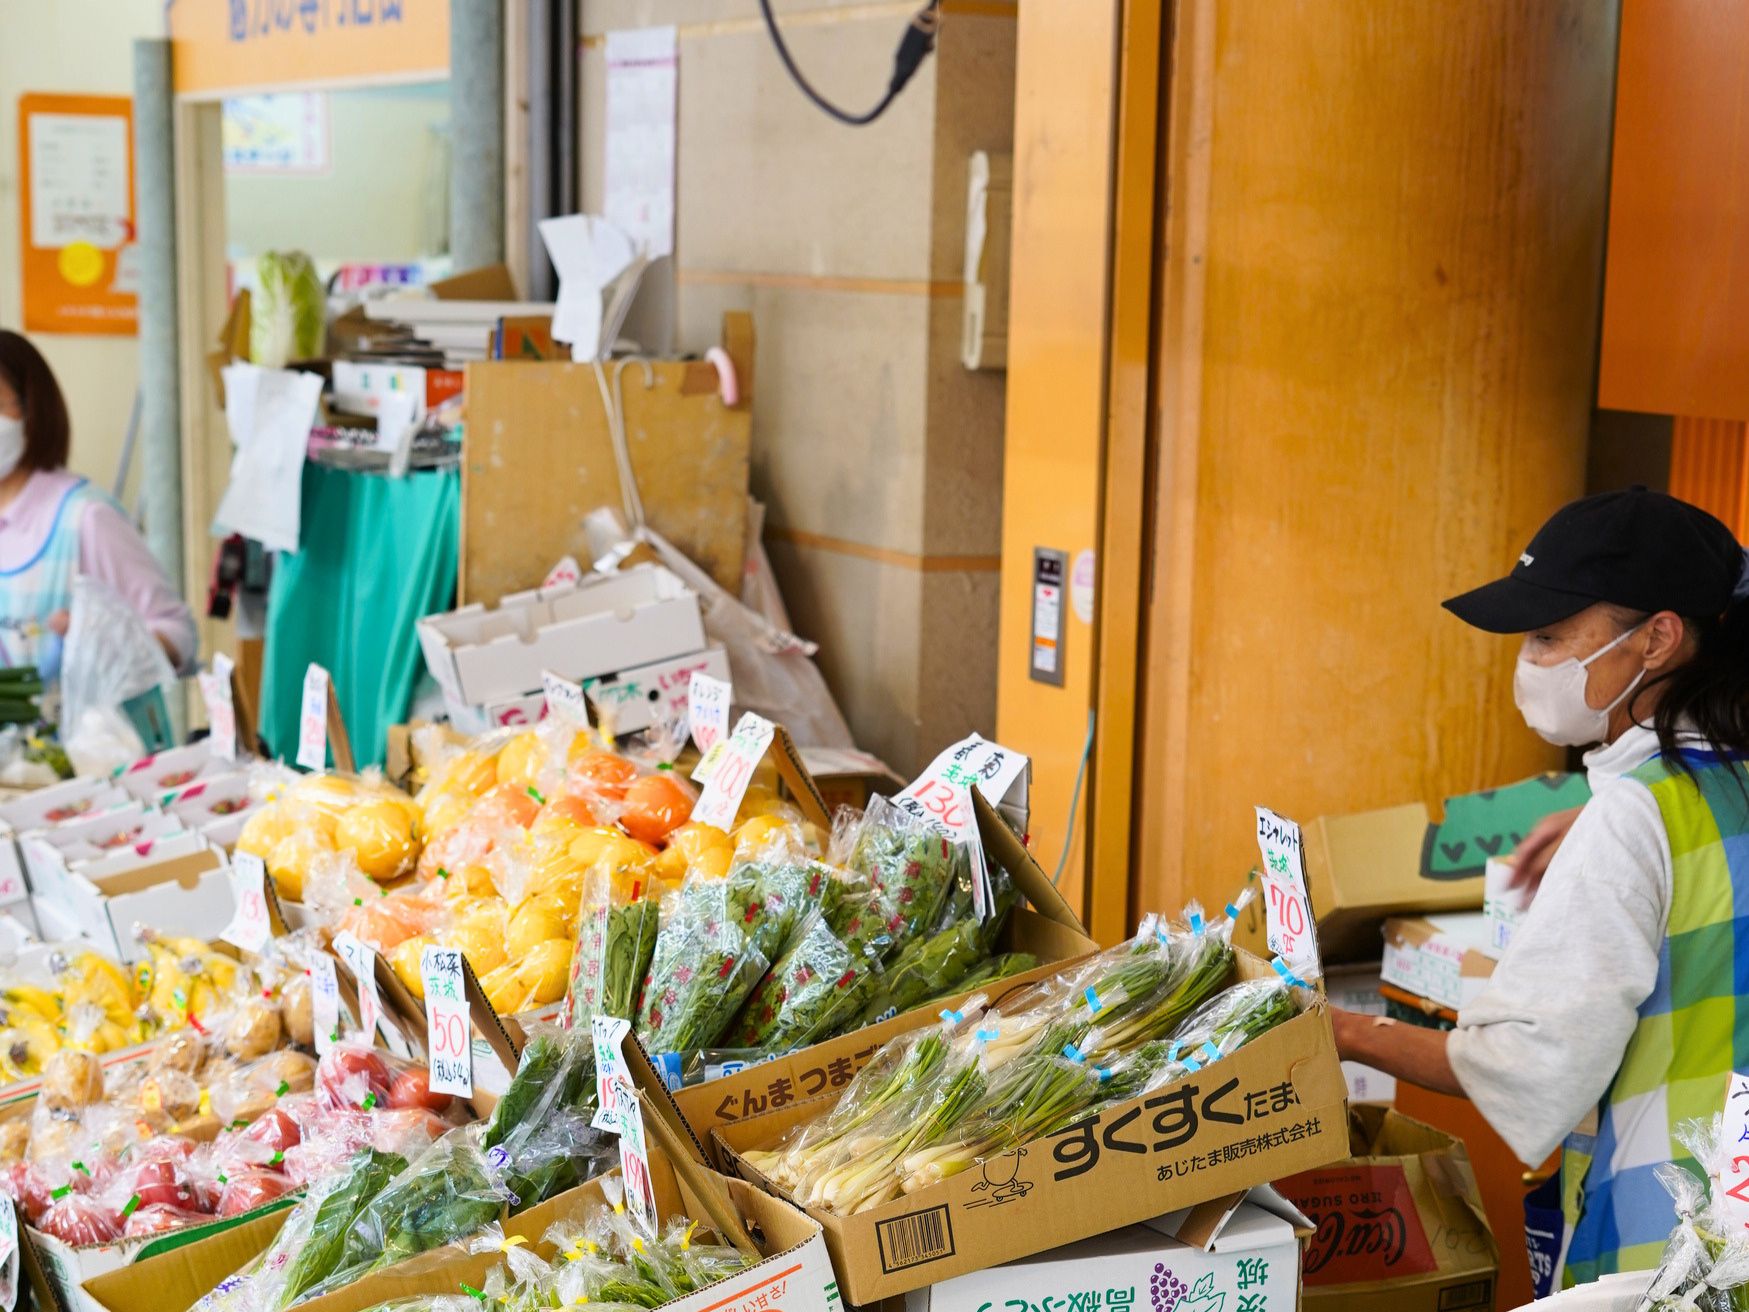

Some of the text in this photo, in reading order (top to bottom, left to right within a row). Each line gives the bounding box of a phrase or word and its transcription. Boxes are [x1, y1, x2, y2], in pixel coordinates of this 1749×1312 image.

[1270, 884, 1304, 936] 70
[433, 1007, 465, 1057] 50
[1156, 1116, 1322, 1182] あじたま販売株式会社
